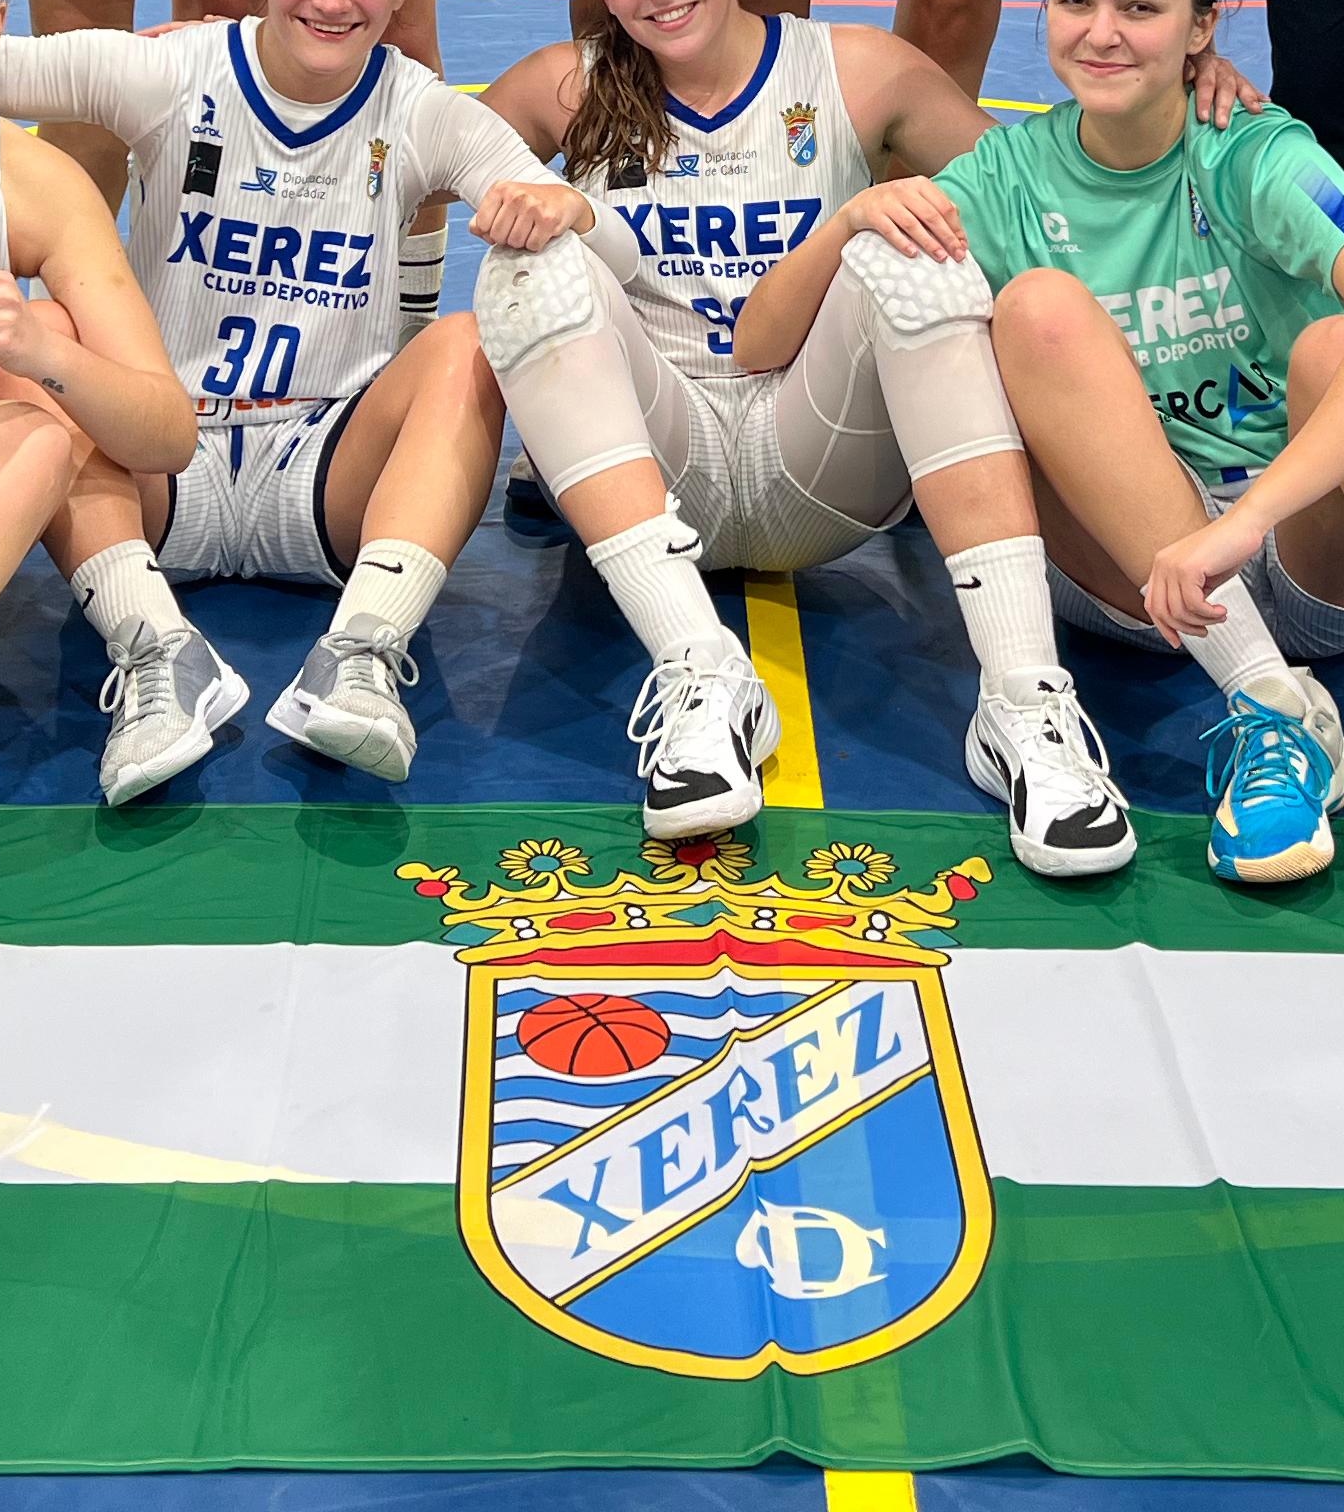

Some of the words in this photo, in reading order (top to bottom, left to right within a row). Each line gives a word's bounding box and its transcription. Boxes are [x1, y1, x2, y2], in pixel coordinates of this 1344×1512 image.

[705, 149, 758, 164] Diputación
[705, 167, 718, 177] de
[720, 164, 749, 176] Cádiz
[281, 188, 297, 200] de
[167, 211, 375, 290] XEREZ
[613, 198, 822, 257] XEREZ
[203, 272, 257, 297] CLUB
[262, 280, 370, 311] DEPORTIVO
[657, 260, 705, 277] CLUB
[1097, 266, 1245, 347] EREZ
[201, 315, 301, 400] 30
[540, 993, 902, 1259] XEREZ
